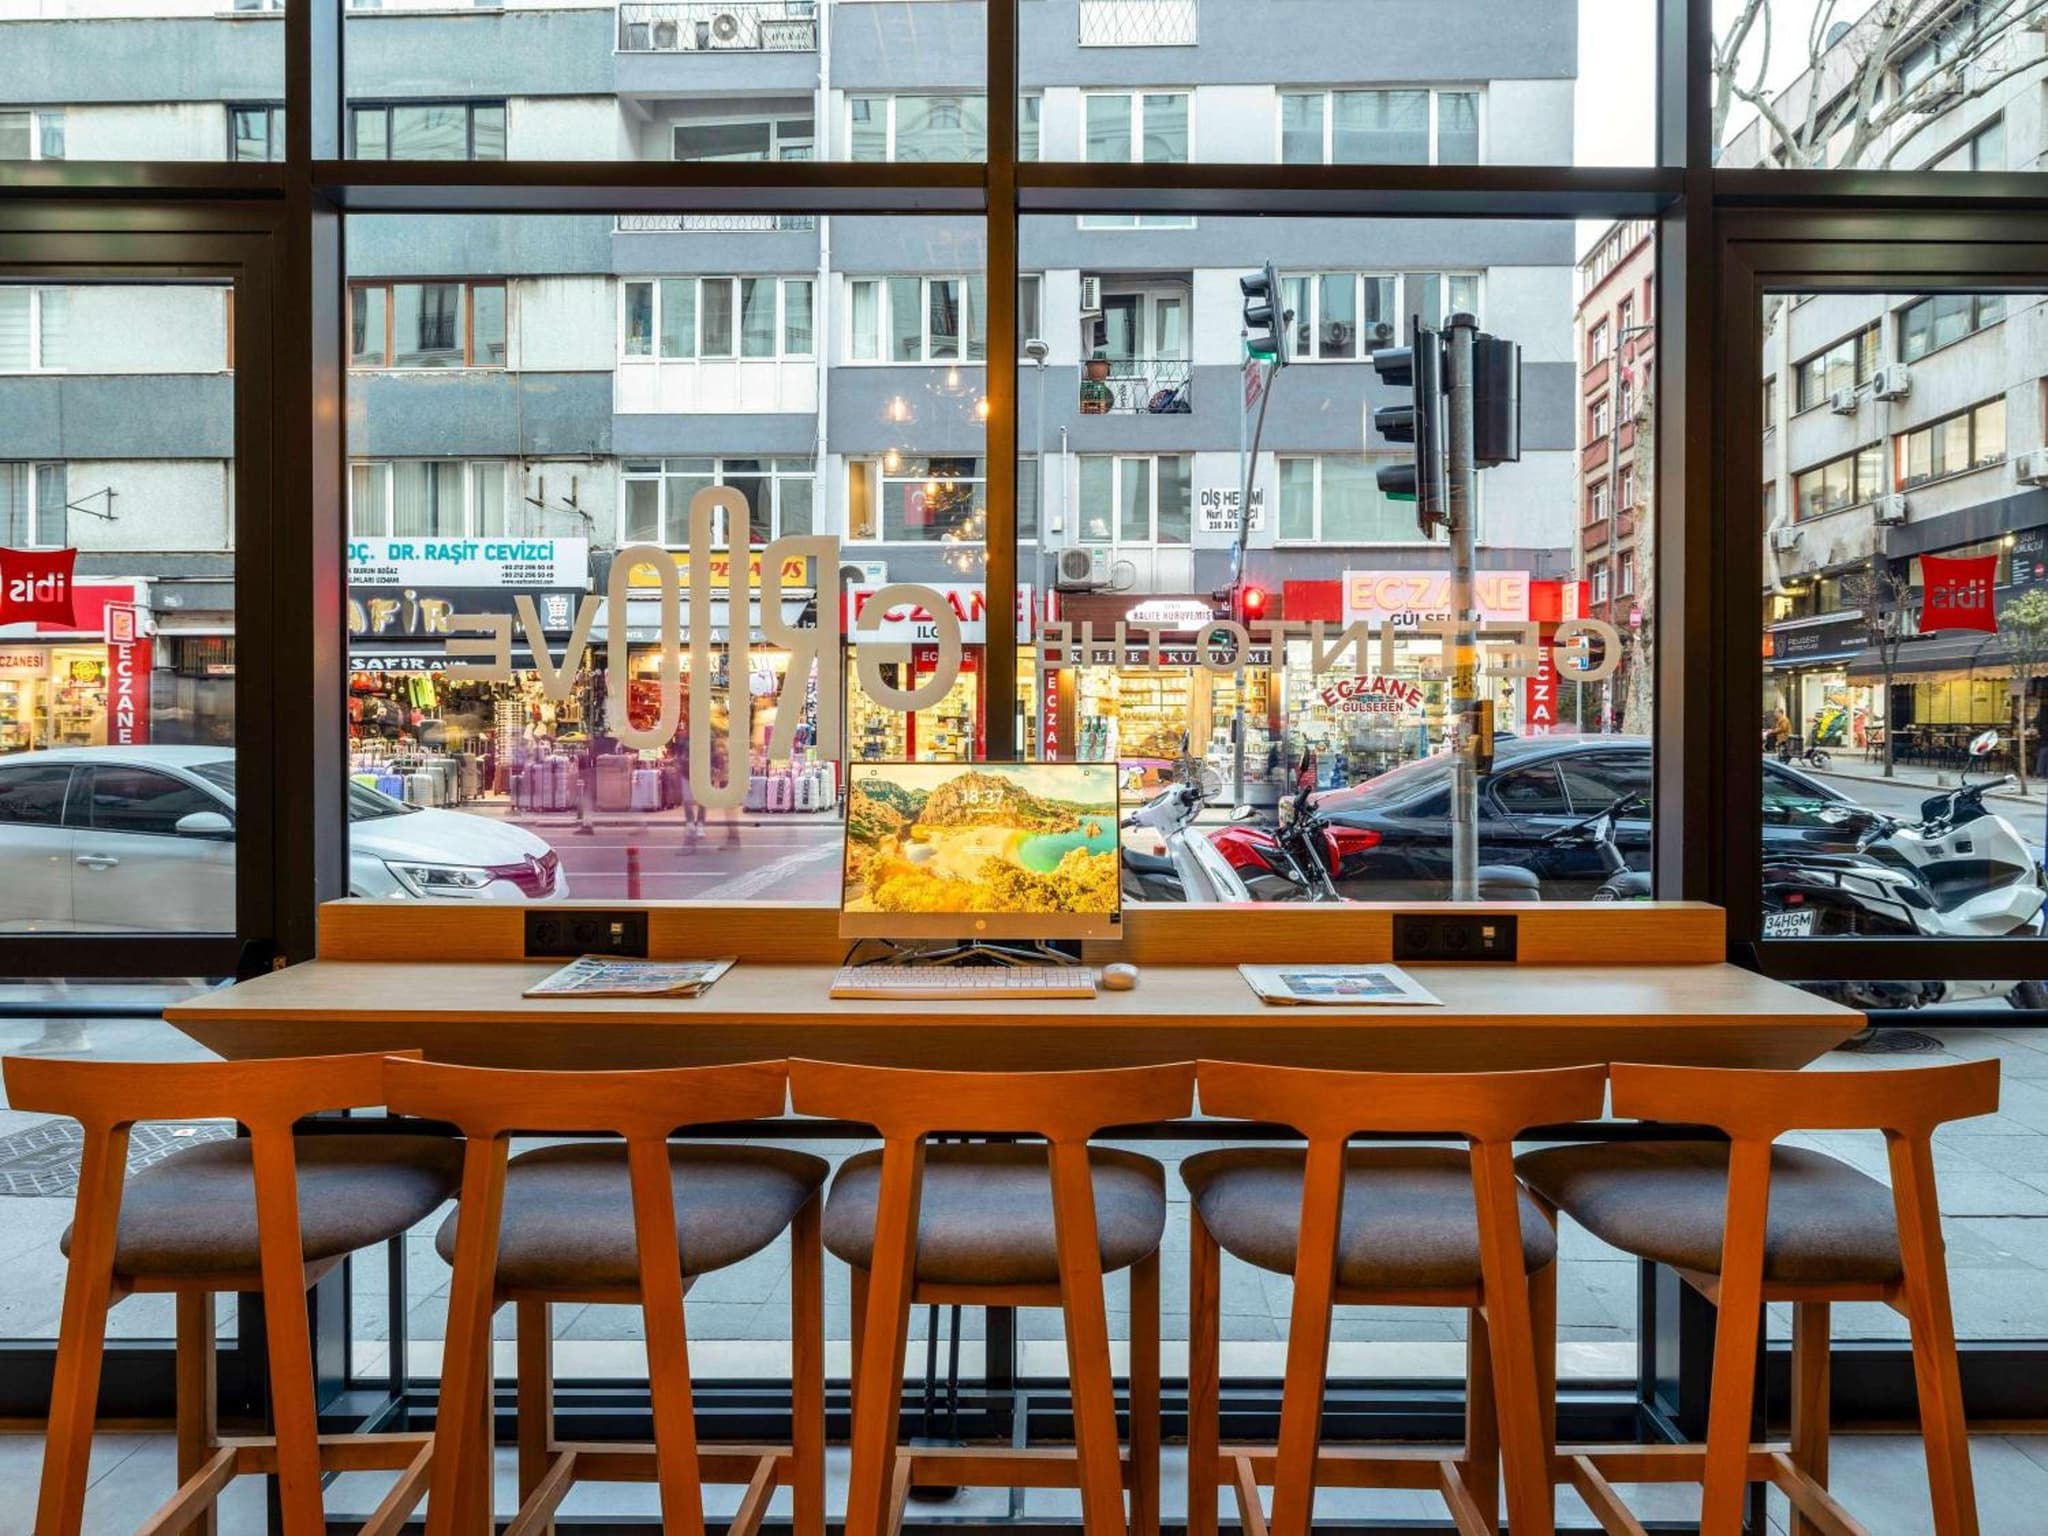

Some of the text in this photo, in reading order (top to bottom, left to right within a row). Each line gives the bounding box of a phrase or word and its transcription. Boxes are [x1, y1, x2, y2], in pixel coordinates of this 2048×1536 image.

[1201, 488, 1264, 509] DİŞ HEMİ
[1206, 508, 1223, 519] Nuri
[388, 544, 420, 561] DR.
[424, 540, 479, 565] RAŞİT
[485, 540, 554, 561] CEVİZCİ
[1350, 576, 1522, 611] ECZANE
[1071, 651, 1140, 662] KLİE
[116, 646, 134, 744] ECZANE
[1320, 675, 1424, 709] ECZANE
